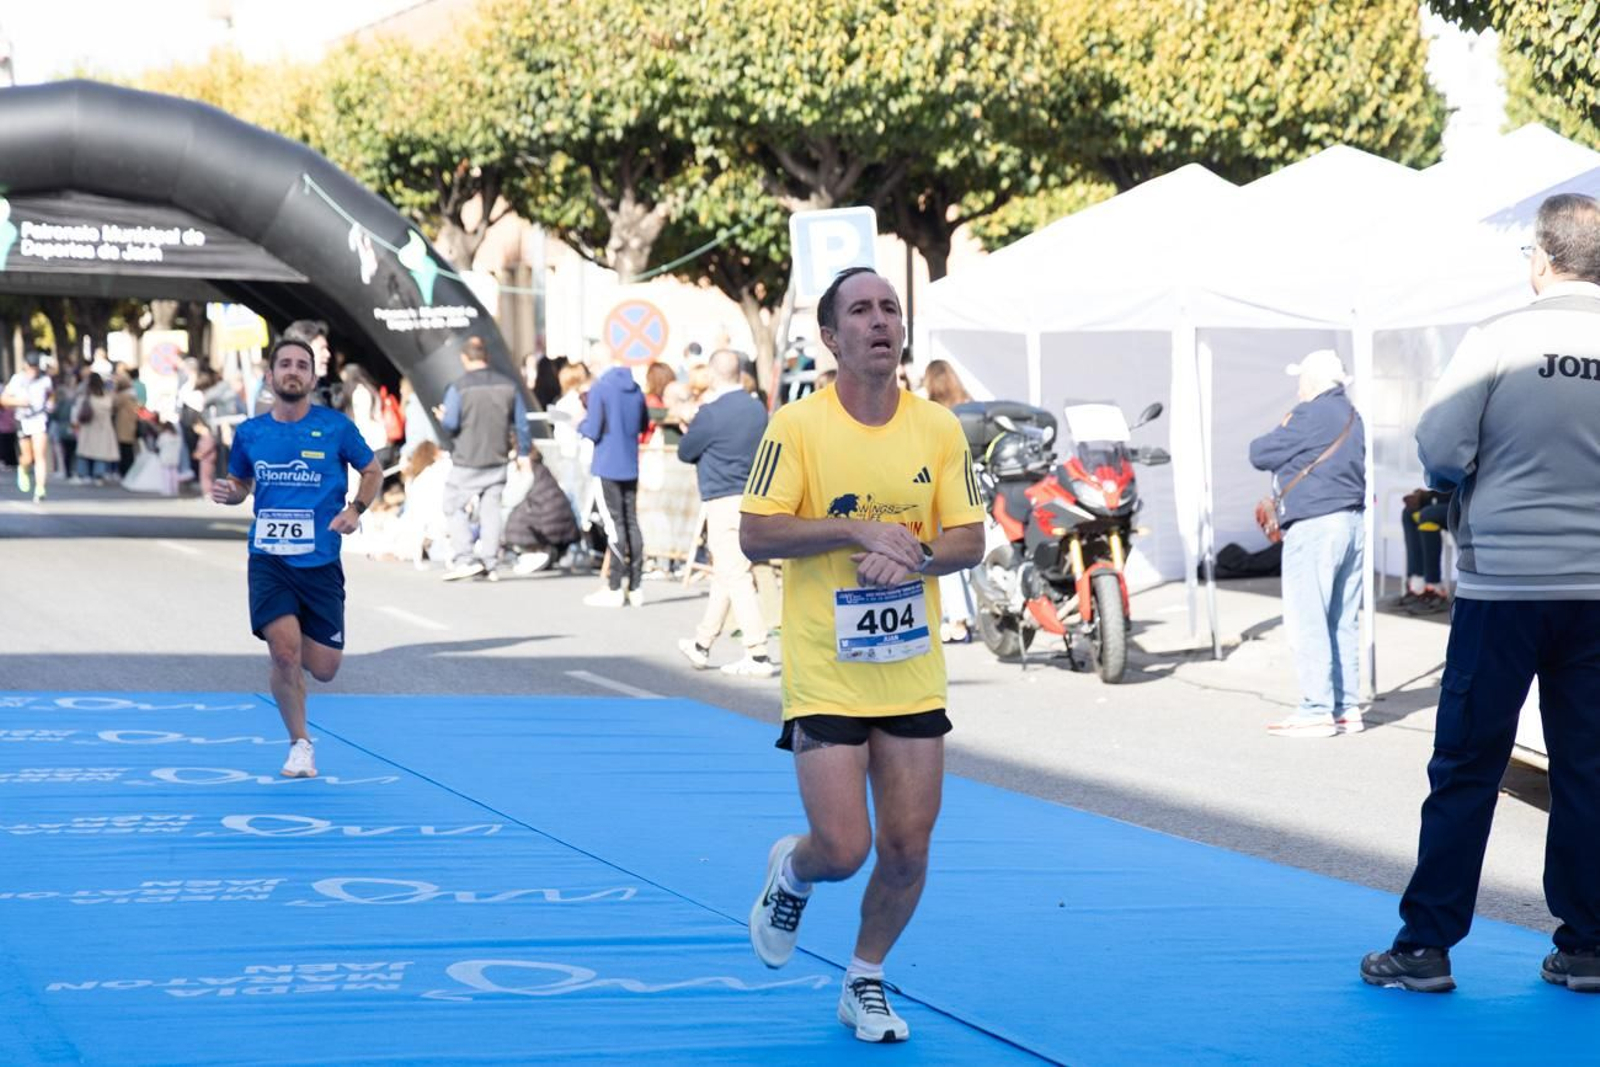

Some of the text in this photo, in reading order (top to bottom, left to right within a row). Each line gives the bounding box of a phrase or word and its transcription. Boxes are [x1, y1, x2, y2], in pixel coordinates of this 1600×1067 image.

[102, 224, 181, 246] Municipal
[182, 228, 206, 246] de
[97, 242, 120, 260] de
[261, 470, 322, 482] Honrubia
[267, 523, 303, 538] 276
[857, 603, 914, 635] 404
[164, 983, 401, 997] MEDIA
